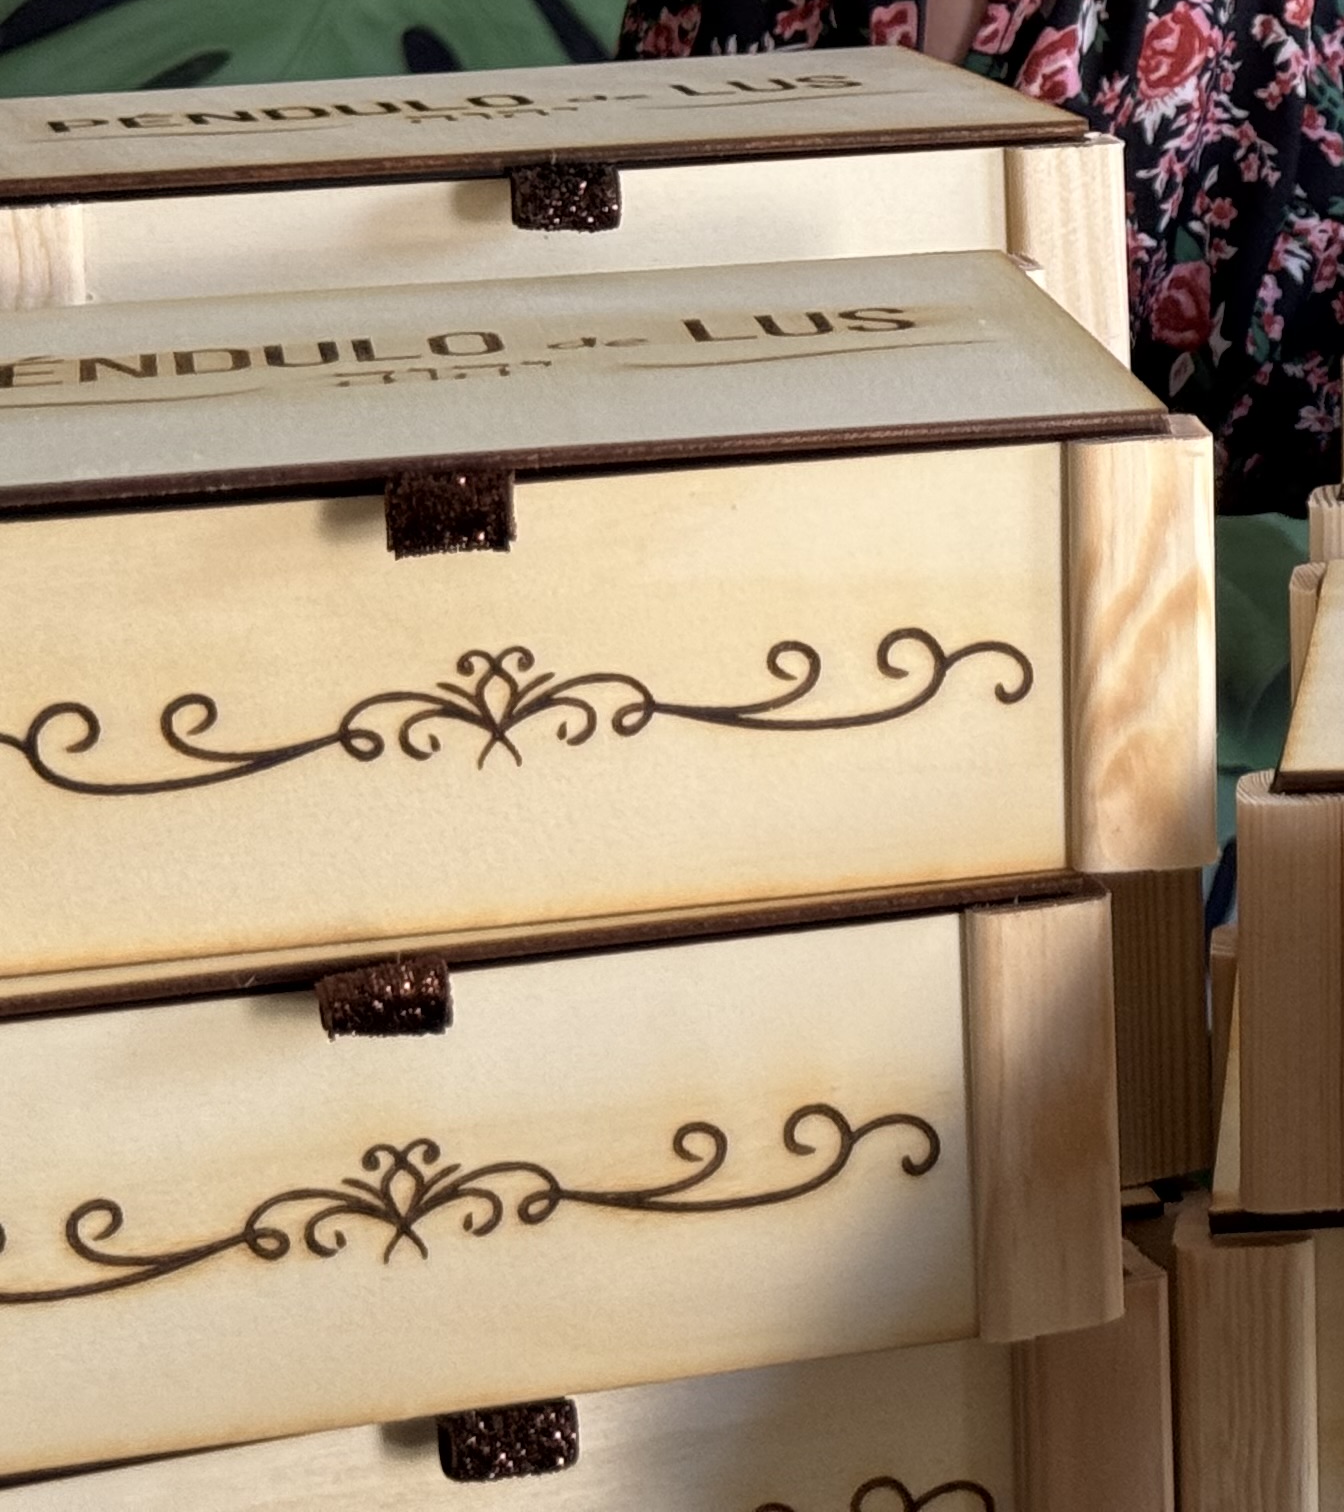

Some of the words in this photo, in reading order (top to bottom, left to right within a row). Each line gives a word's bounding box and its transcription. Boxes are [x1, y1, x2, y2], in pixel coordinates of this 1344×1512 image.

[669, 74, 863, 96] LUS
[0, 331, 504, 387] ÉNDULO
[682, 307, 916, 342] LUS
